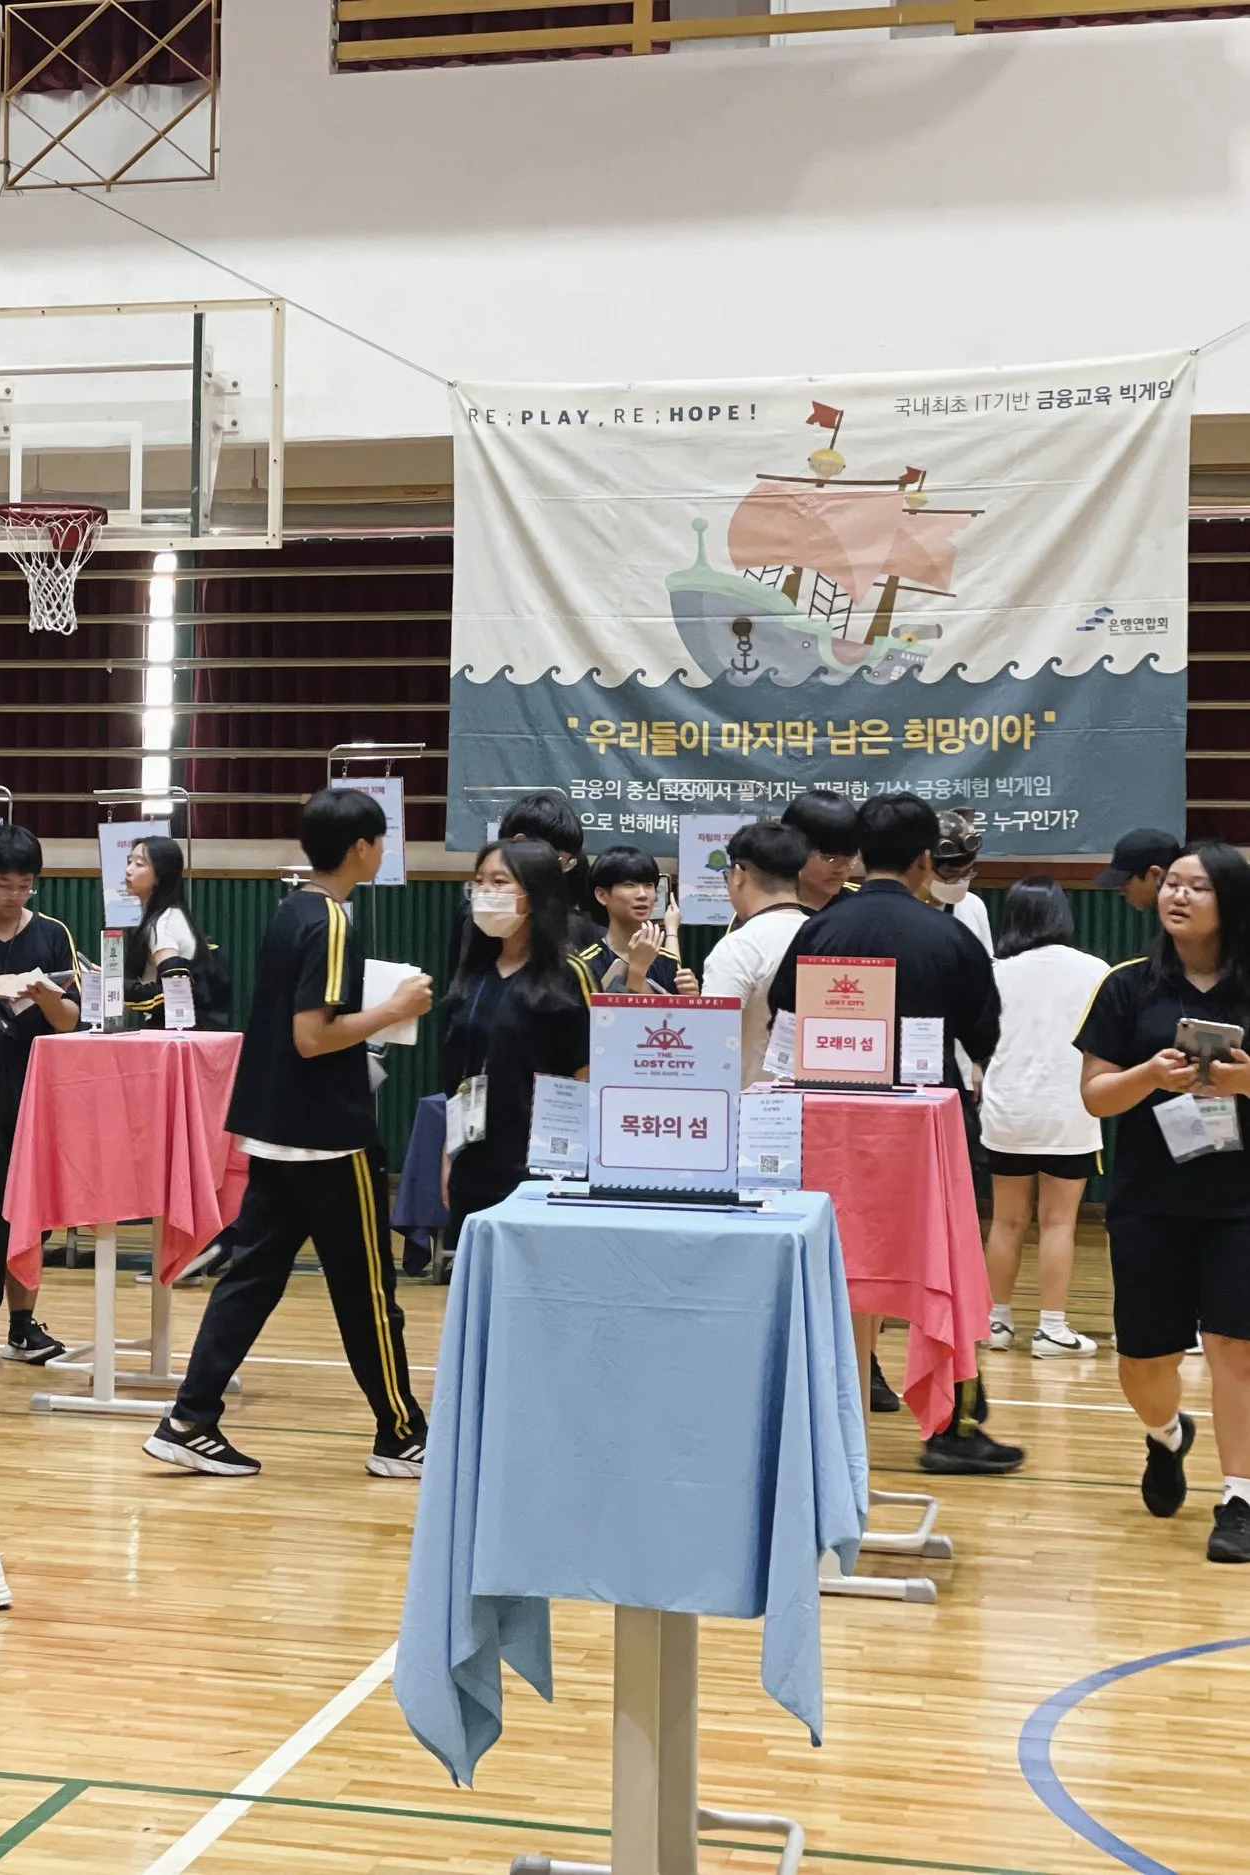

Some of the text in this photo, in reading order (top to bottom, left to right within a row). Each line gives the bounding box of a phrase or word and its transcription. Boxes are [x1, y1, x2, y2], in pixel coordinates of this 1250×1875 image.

[894, 379, 1174, 417] 국내최초 IT기반 금융교육 빅게임
[1108, 617, 1168, 632] 은행연합회
[721, 720, 818, 756] 마지막
[827, 719, 893, 755] 남은
[569, 780, 621, 800] 금융의
[626, 780, 732, 801] 중심현장에서
[915, 777, 990, 799] 금융체험
[995, 775, 1052, 797] 빅게임
[993, 809, 1080, 832] 누구인가?
[816, 1035, 873, 1052] 모래의 섬
[634, 1060, 695, 1069] LOST CITY
[620, 1114, 708, 1139] 목화의 섬
